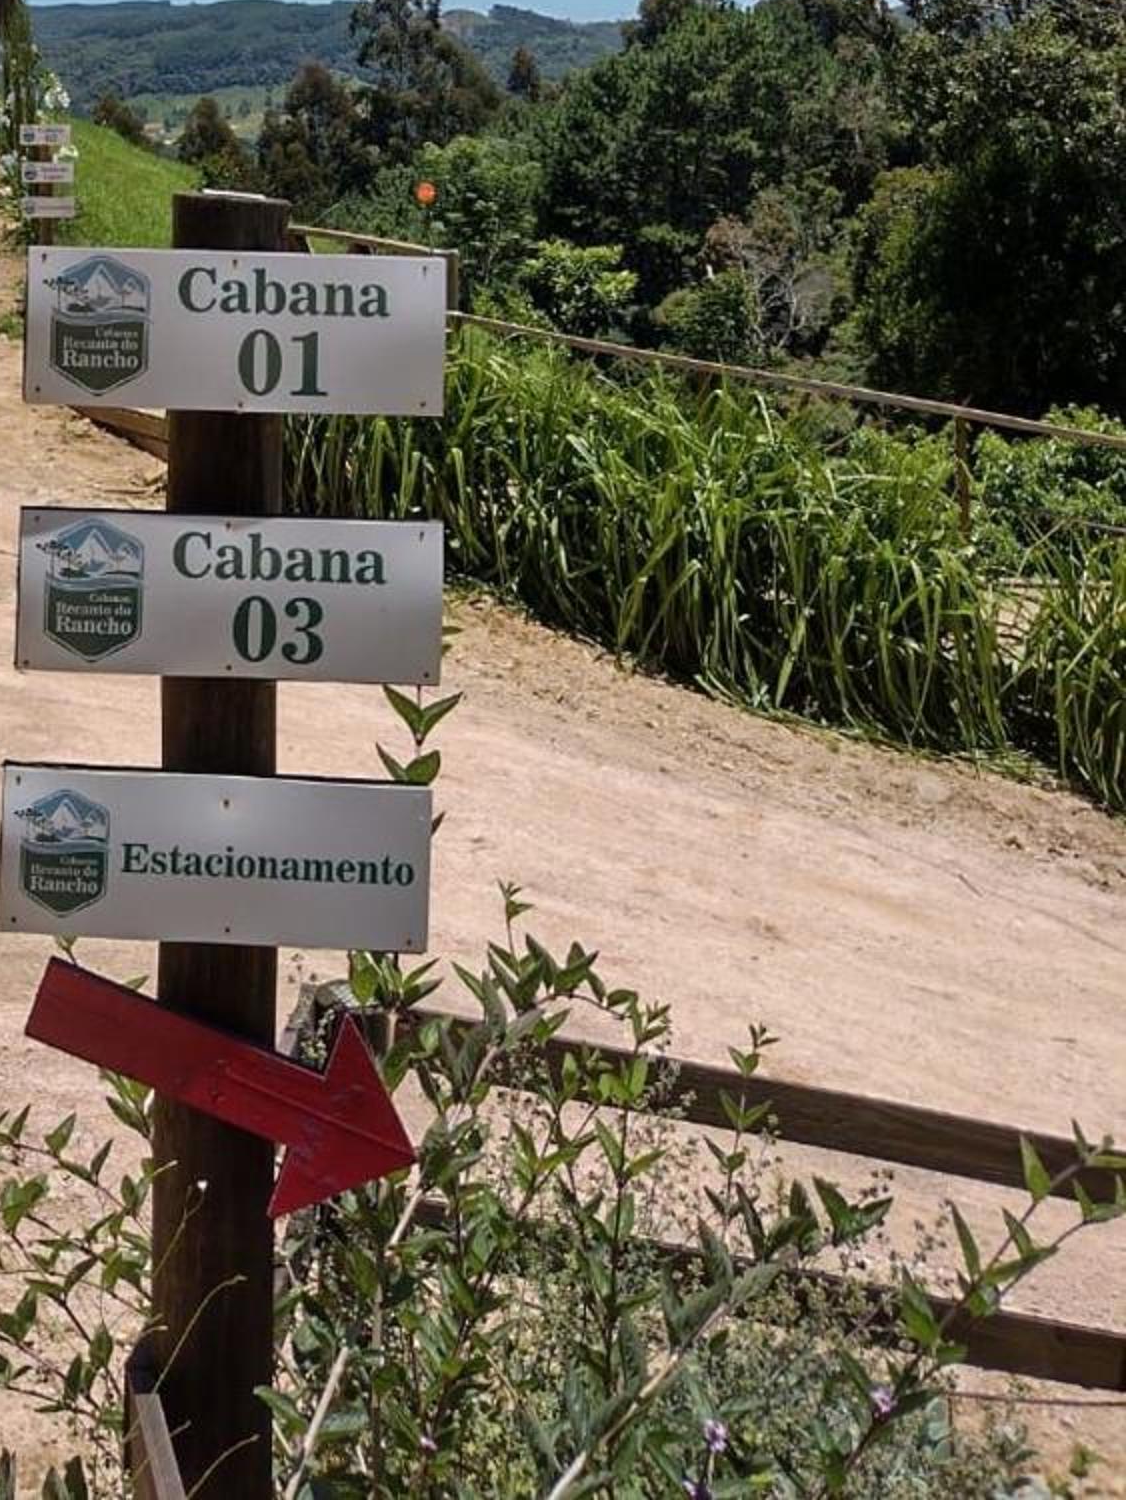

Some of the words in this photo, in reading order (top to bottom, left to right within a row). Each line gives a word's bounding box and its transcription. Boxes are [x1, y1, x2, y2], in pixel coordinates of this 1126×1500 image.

[177, 266, 391, 318] Cabana
[61, 349, 139, 369] Rancho
[237, 329, 329, 397] 01
[173, 531, 387, 585] Cabana
[56, 615, 132, 636] Rancho
[232, 595, 325, 665] 03
[30, 875, 99, 895] Rancho
[121, 843, 415, 887] Estacionamento
